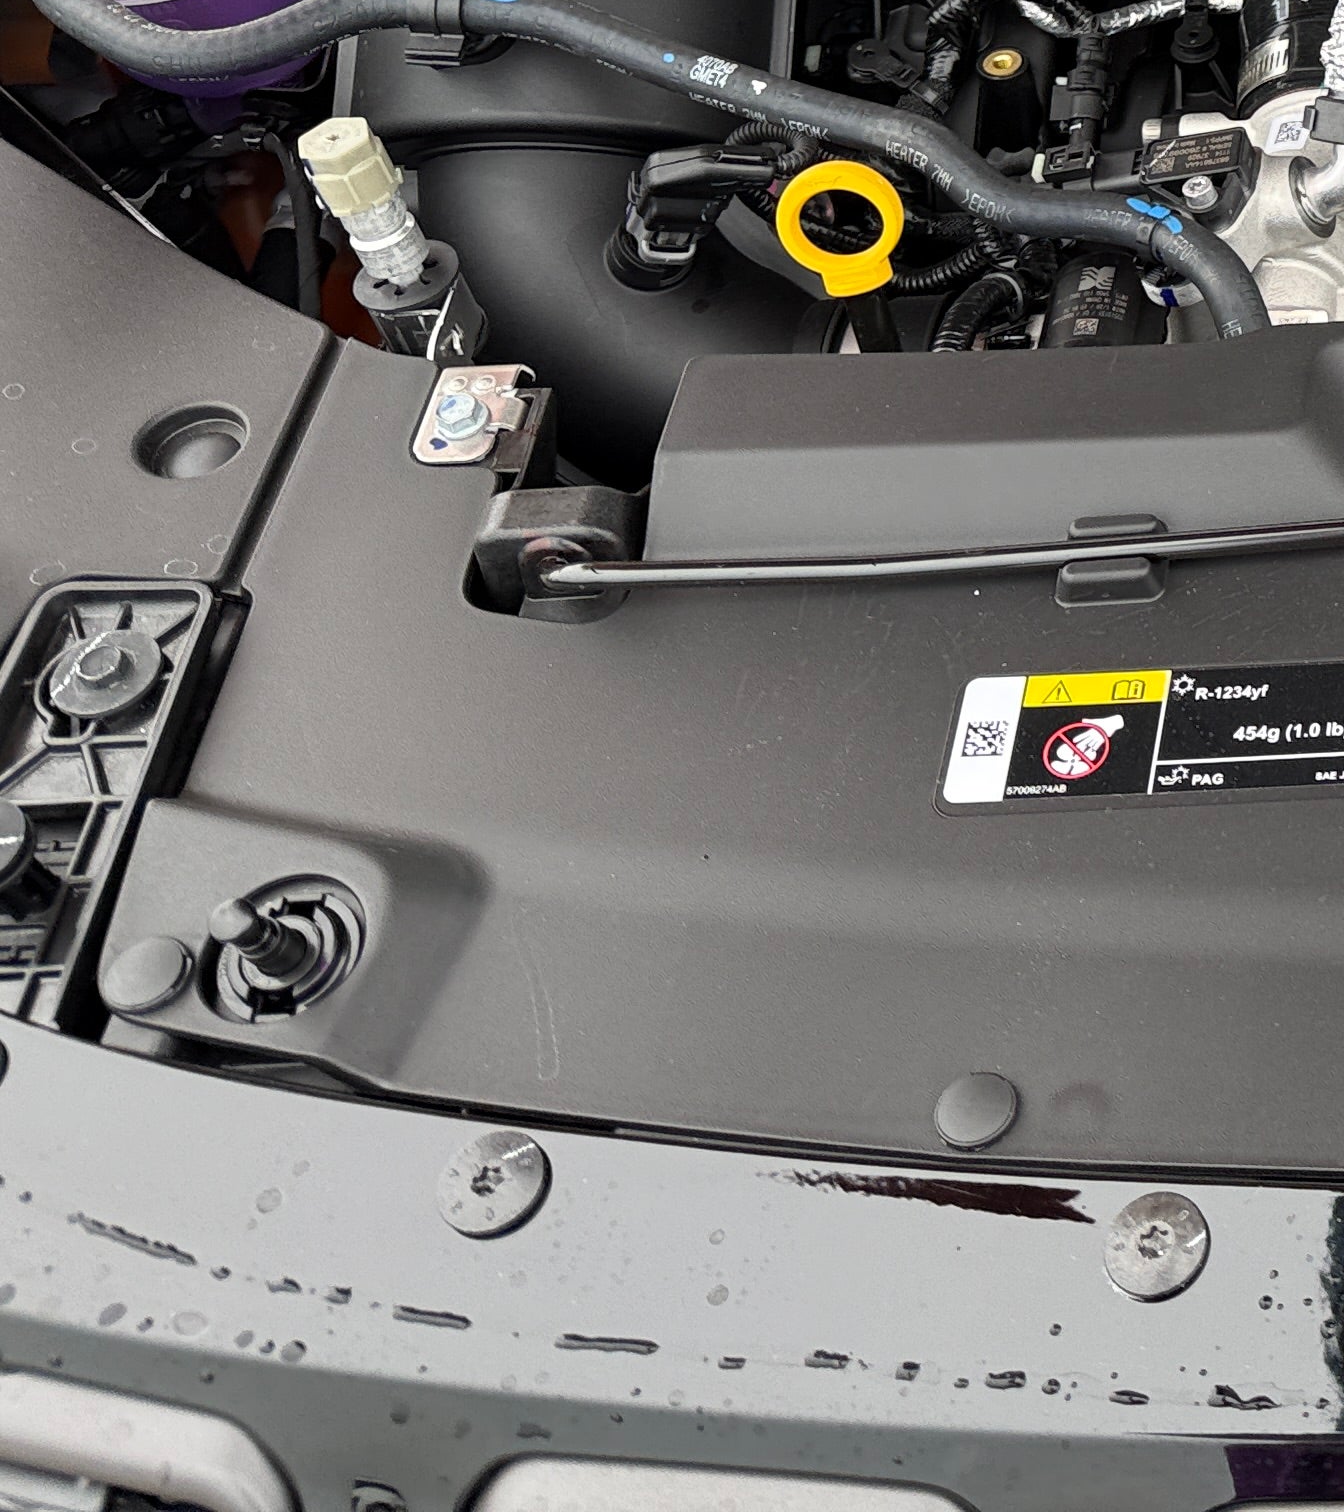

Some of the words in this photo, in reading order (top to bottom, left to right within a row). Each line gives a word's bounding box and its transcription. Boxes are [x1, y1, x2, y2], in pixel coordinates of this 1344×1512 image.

[885, 140, 929, 172] HEATER
[1194, 683, 1270, 701] R-1234yf
[1233, 724, 1281, 743] 454g
[1285, 723, 1320, 742] (1.0
[1191, 773, 1225, 786] PAG
[1315, 771, 1337, 781] SAE
